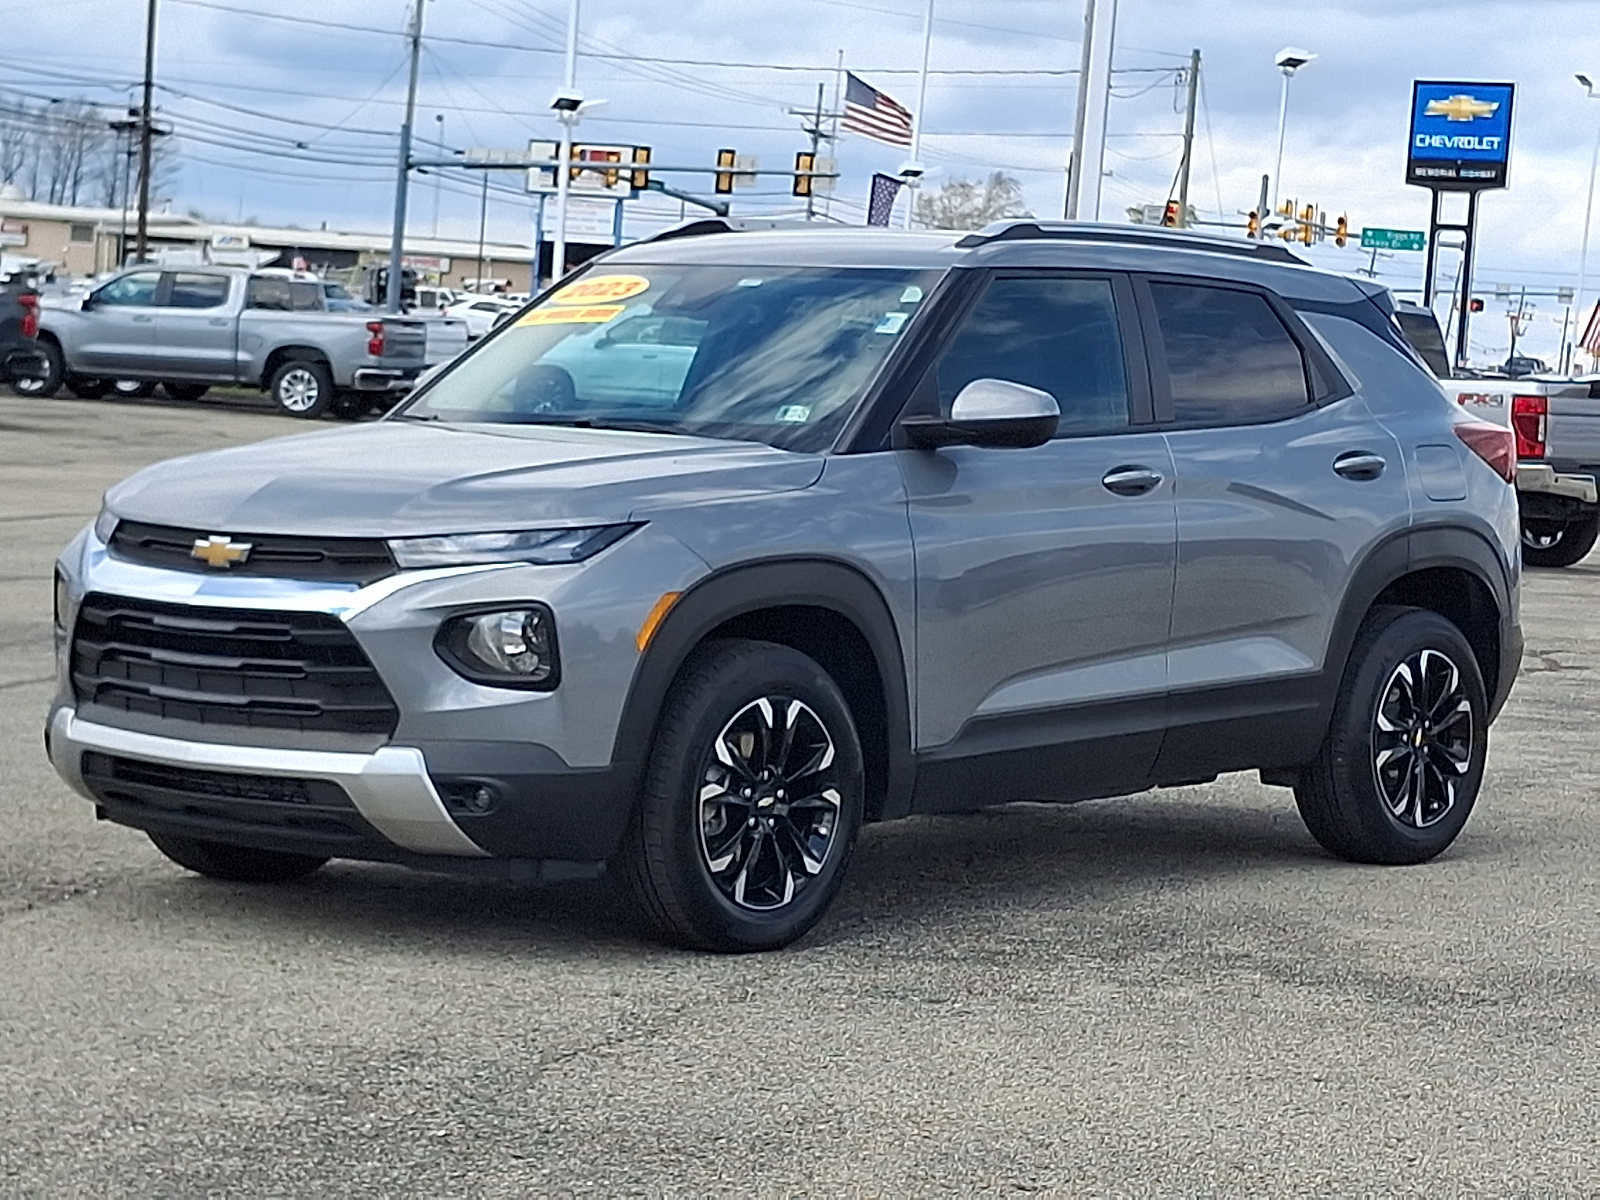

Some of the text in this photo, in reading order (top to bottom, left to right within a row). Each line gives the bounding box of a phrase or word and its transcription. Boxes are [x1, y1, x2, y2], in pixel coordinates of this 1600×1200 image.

[1415, 134, 1501, 150] CHEVROLET
[557, 281, 641, 299] 2023
[1457, 393, 1504, 408] FX4
